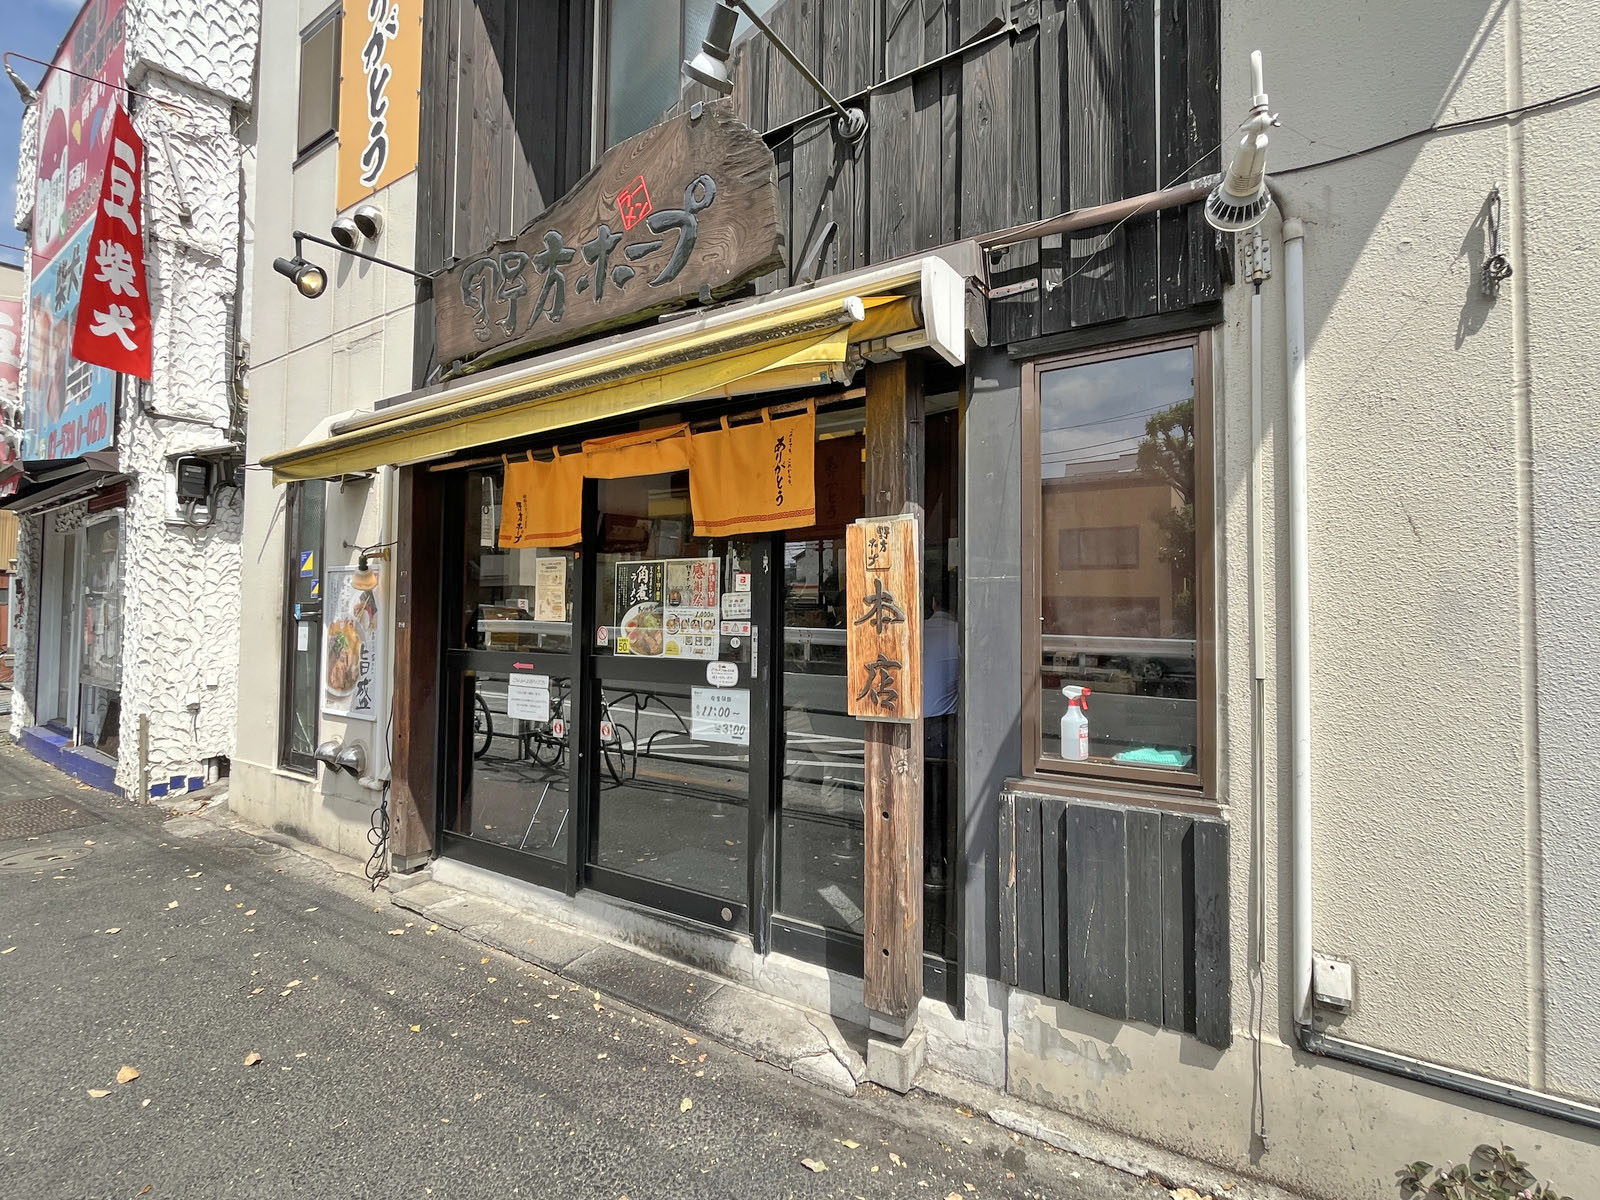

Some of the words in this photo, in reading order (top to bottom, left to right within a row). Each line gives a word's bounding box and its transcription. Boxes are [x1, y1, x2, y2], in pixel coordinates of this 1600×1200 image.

[89, 137, 140, 352] 豆柴犬
[460, 173, 717, 342] 野方ホープ
[774, 436, 786, 507] ありがとう
[876, 525, 891, 553] 野方
[629, 572, 637, 606] ラーメン
[636, 565, 649, 601] 角煮
[692, 562, 705, 606] 感謝祭
[854, 578, 906, 711] 本店
